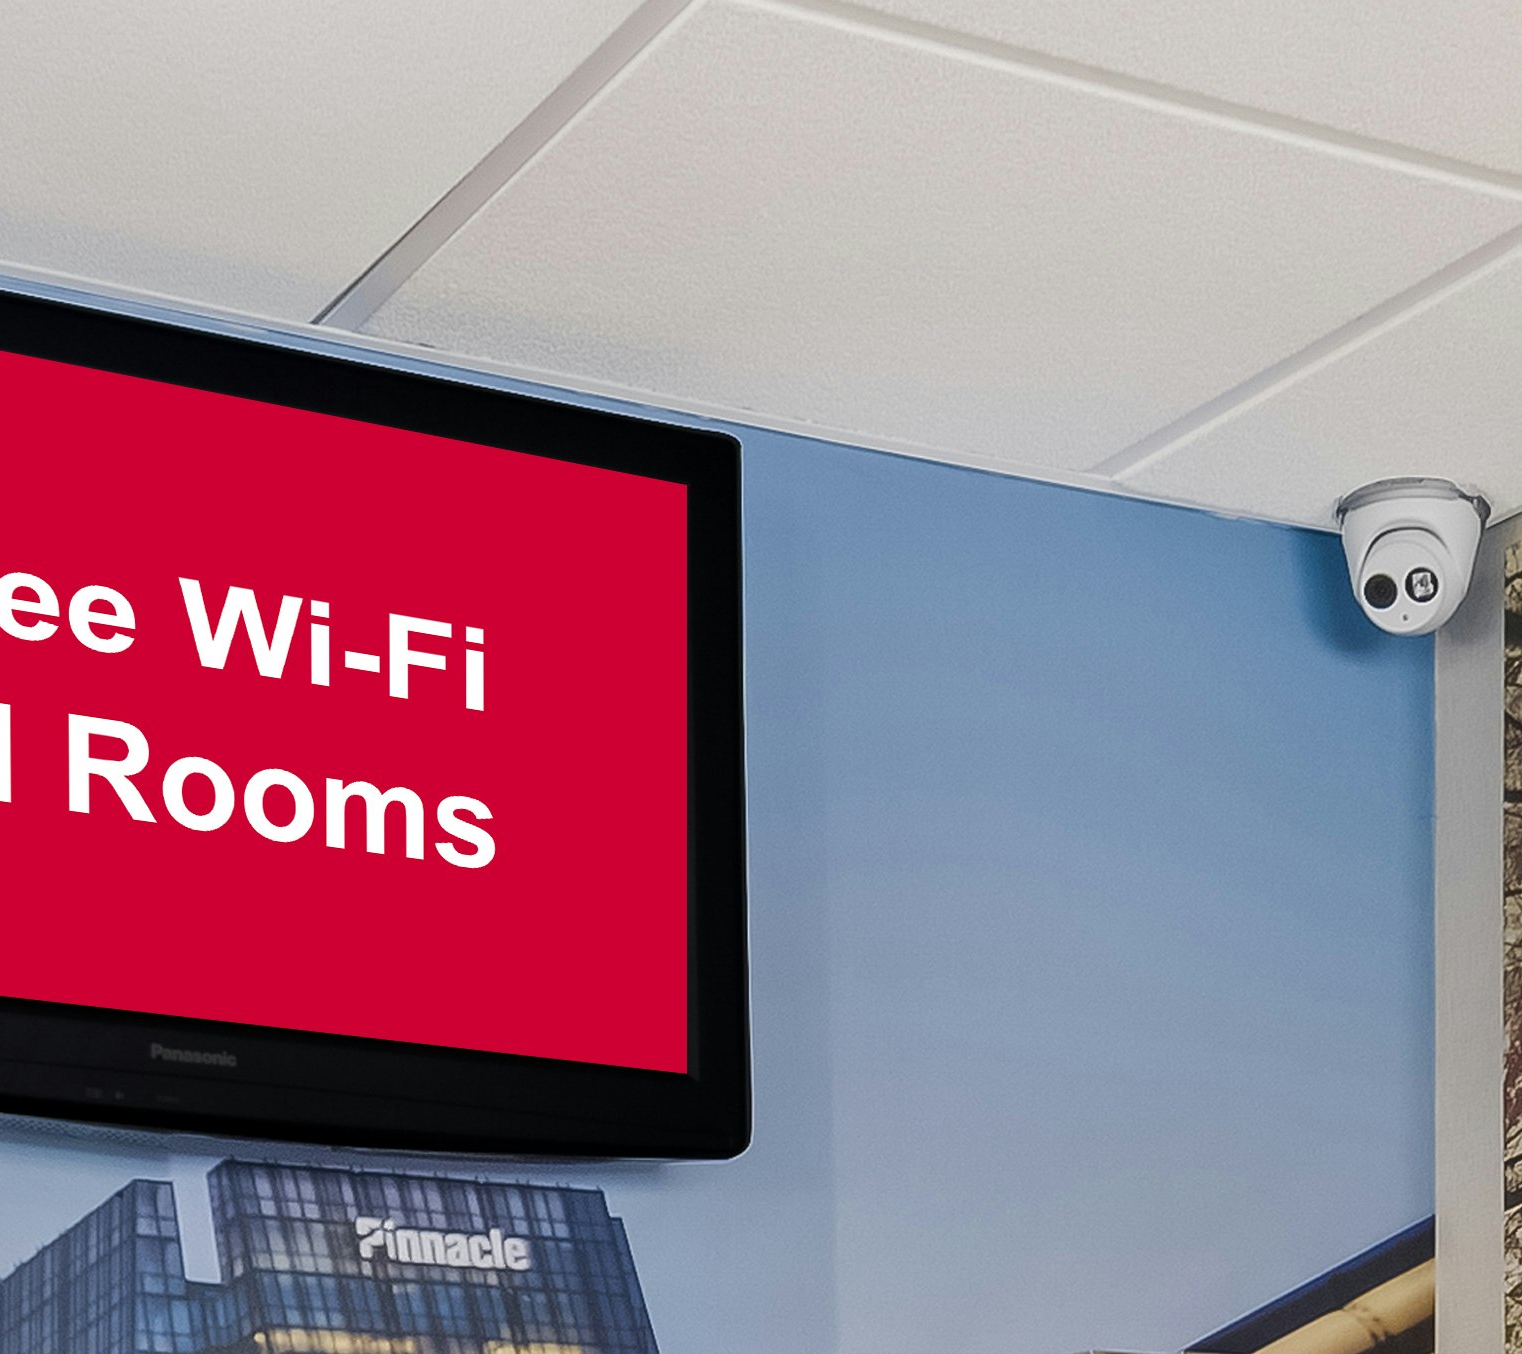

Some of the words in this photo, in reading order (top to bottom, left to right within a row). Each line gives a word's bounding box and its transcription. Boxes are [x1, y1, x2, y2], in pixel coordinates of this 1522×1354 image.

[178, 577, 485, 712] Wi-Fi
[68, 713, 496, 869] Rooms
[150, 1043, 238, 1067] Panasonic
[356, 1217, 530, 1270] Pinnacle
